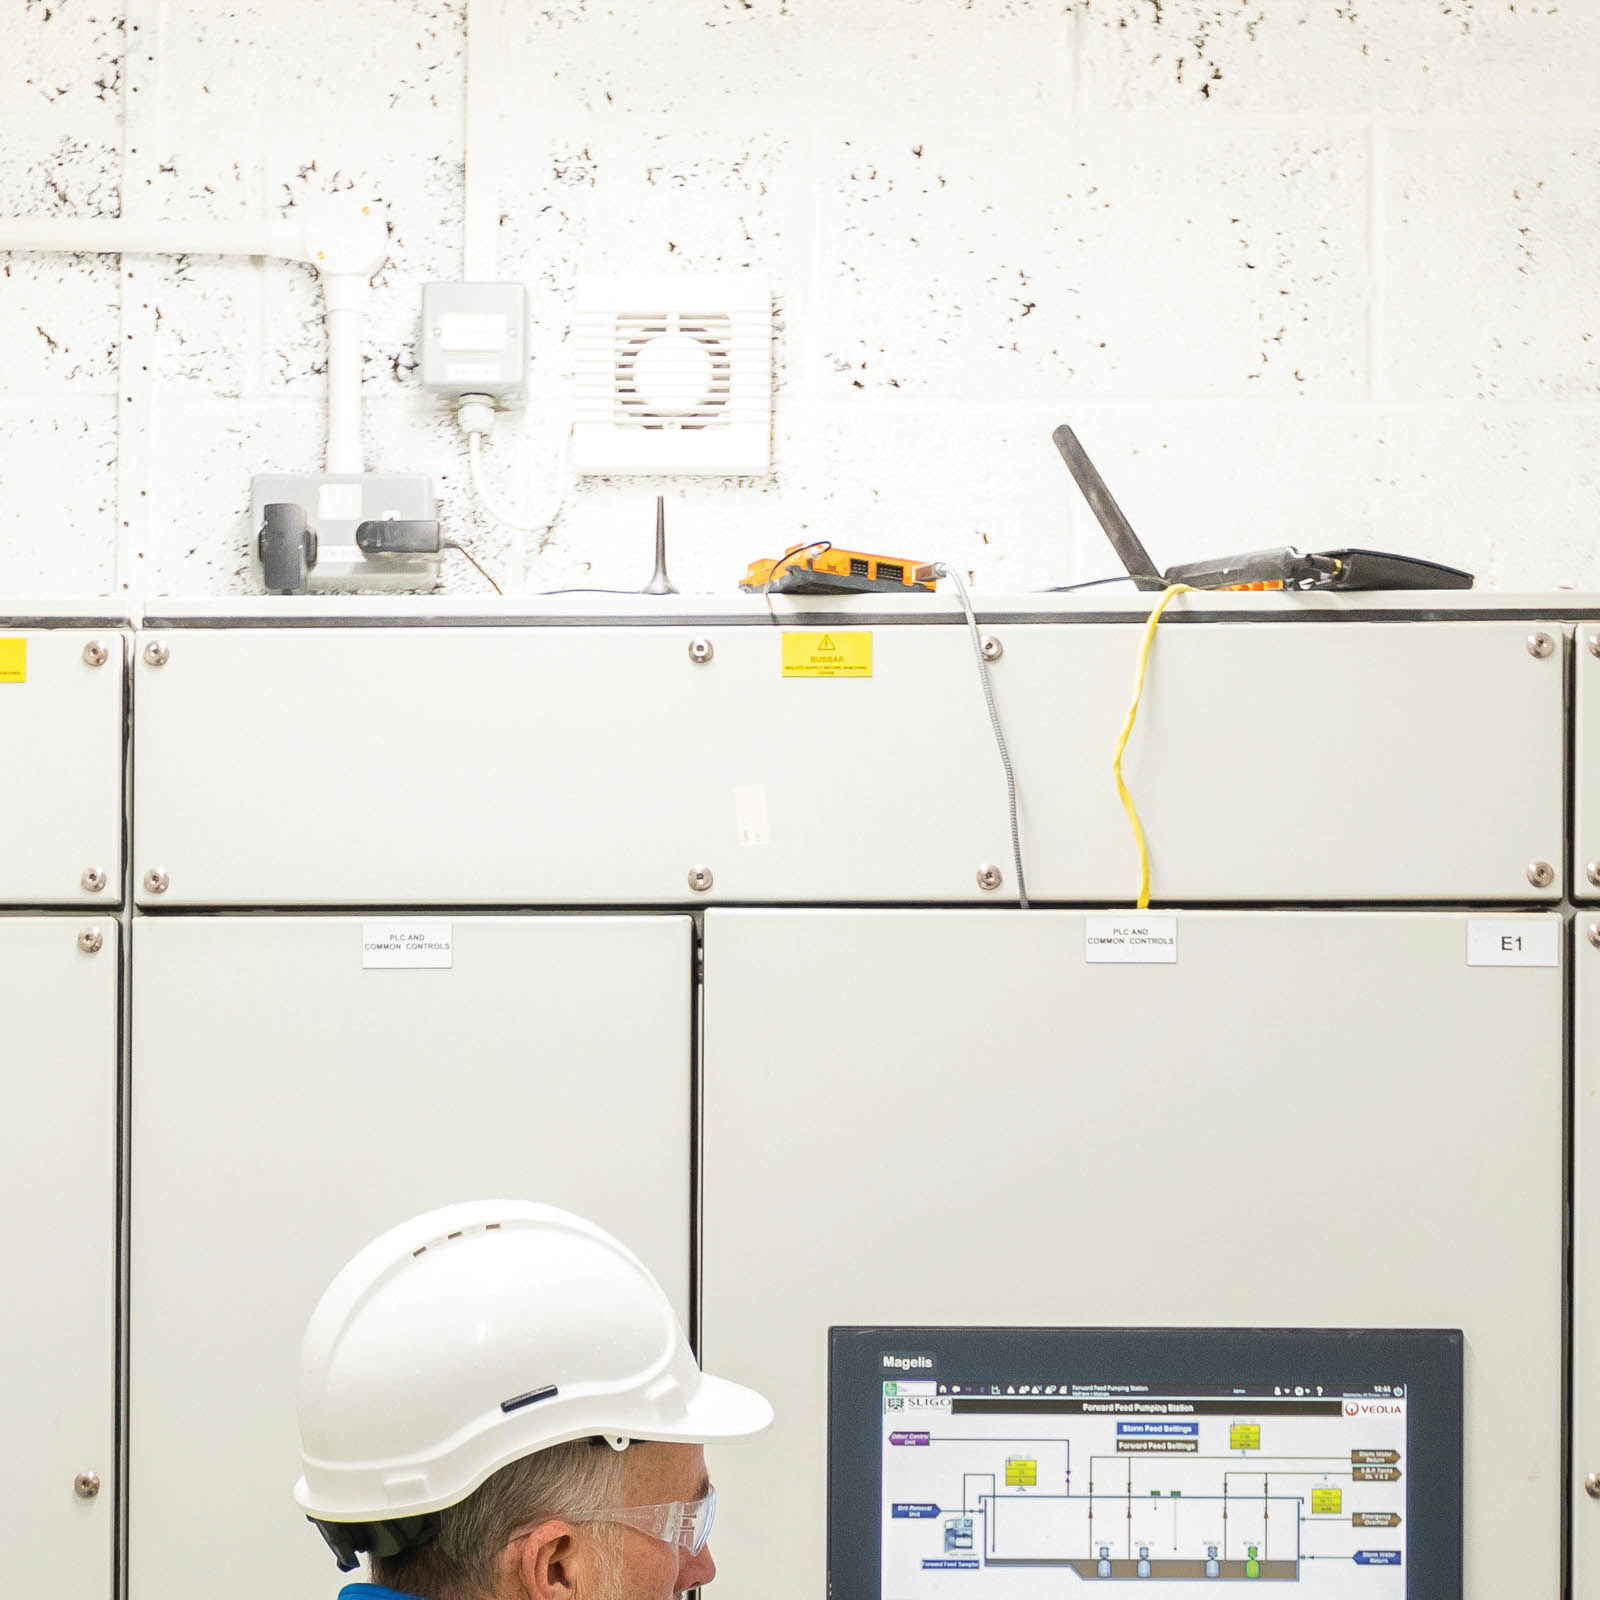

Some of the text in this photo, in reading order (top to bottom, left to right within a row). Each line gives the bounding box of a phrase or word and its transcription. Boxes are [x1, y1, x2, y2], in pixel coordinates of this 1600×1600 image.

[1501, 935, 1522, 952] E1
[883, 1356, 933, 1370] Magelis
[907, 1398, 952, 1406] SLIGO
[1082, 1403, 1194, 1413] Forward Feed Pumping Station
[1361, 1405, 1401, 1414] VEOLIA
[1122, 1425, 1192, 1434] Storm Feed Settings
[1119, 1442, 1196, 1451] Forward Feed Settings
